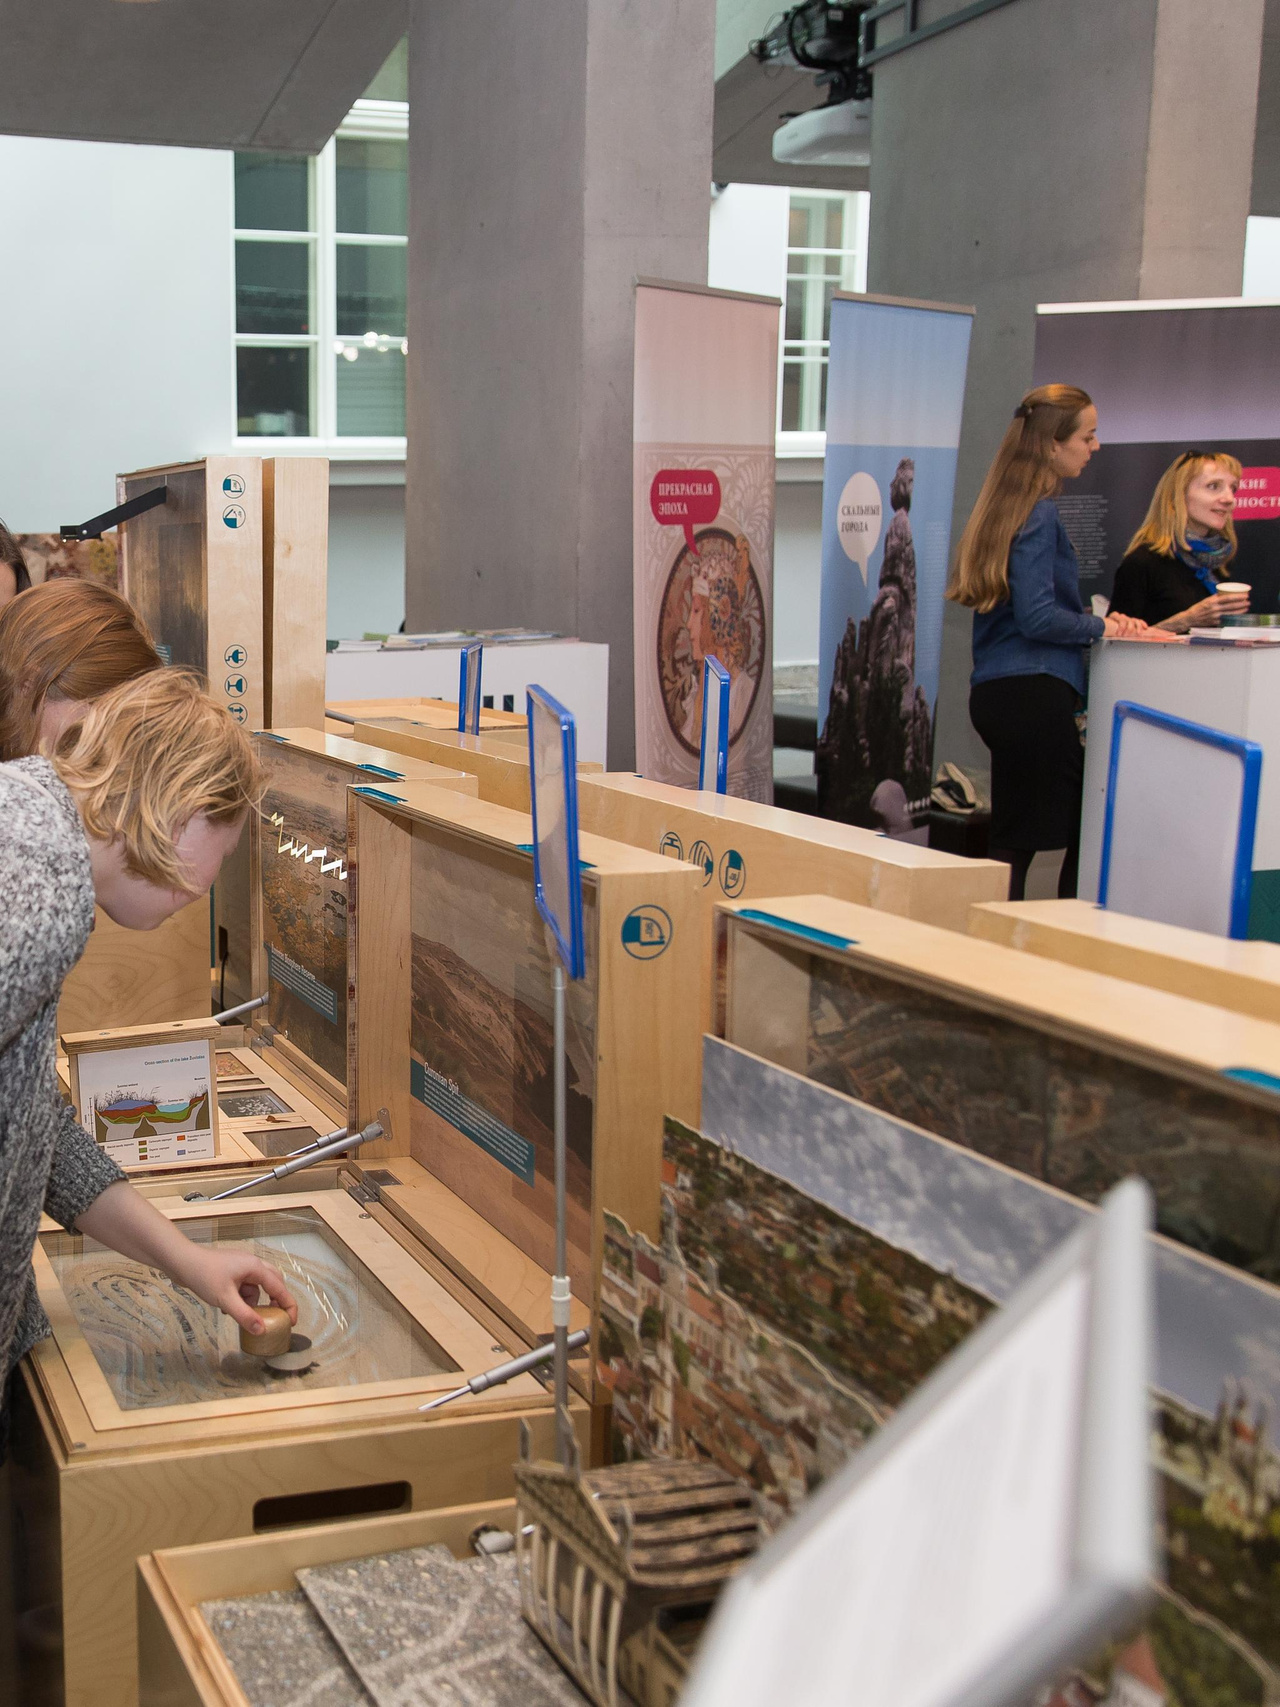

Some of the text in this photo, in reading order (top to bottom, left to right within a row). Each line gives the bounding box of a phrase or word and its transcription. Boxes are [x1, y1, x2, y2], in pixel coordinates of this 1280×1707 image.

[658, 482, 714, 496] ПРЕКРАСНАЯ
[1238, 478, 1268, 490] КИЕ
[658, 502, 689, 515] ЭПОХА
[424, 1061, 460, 1096] Curonian Spit
